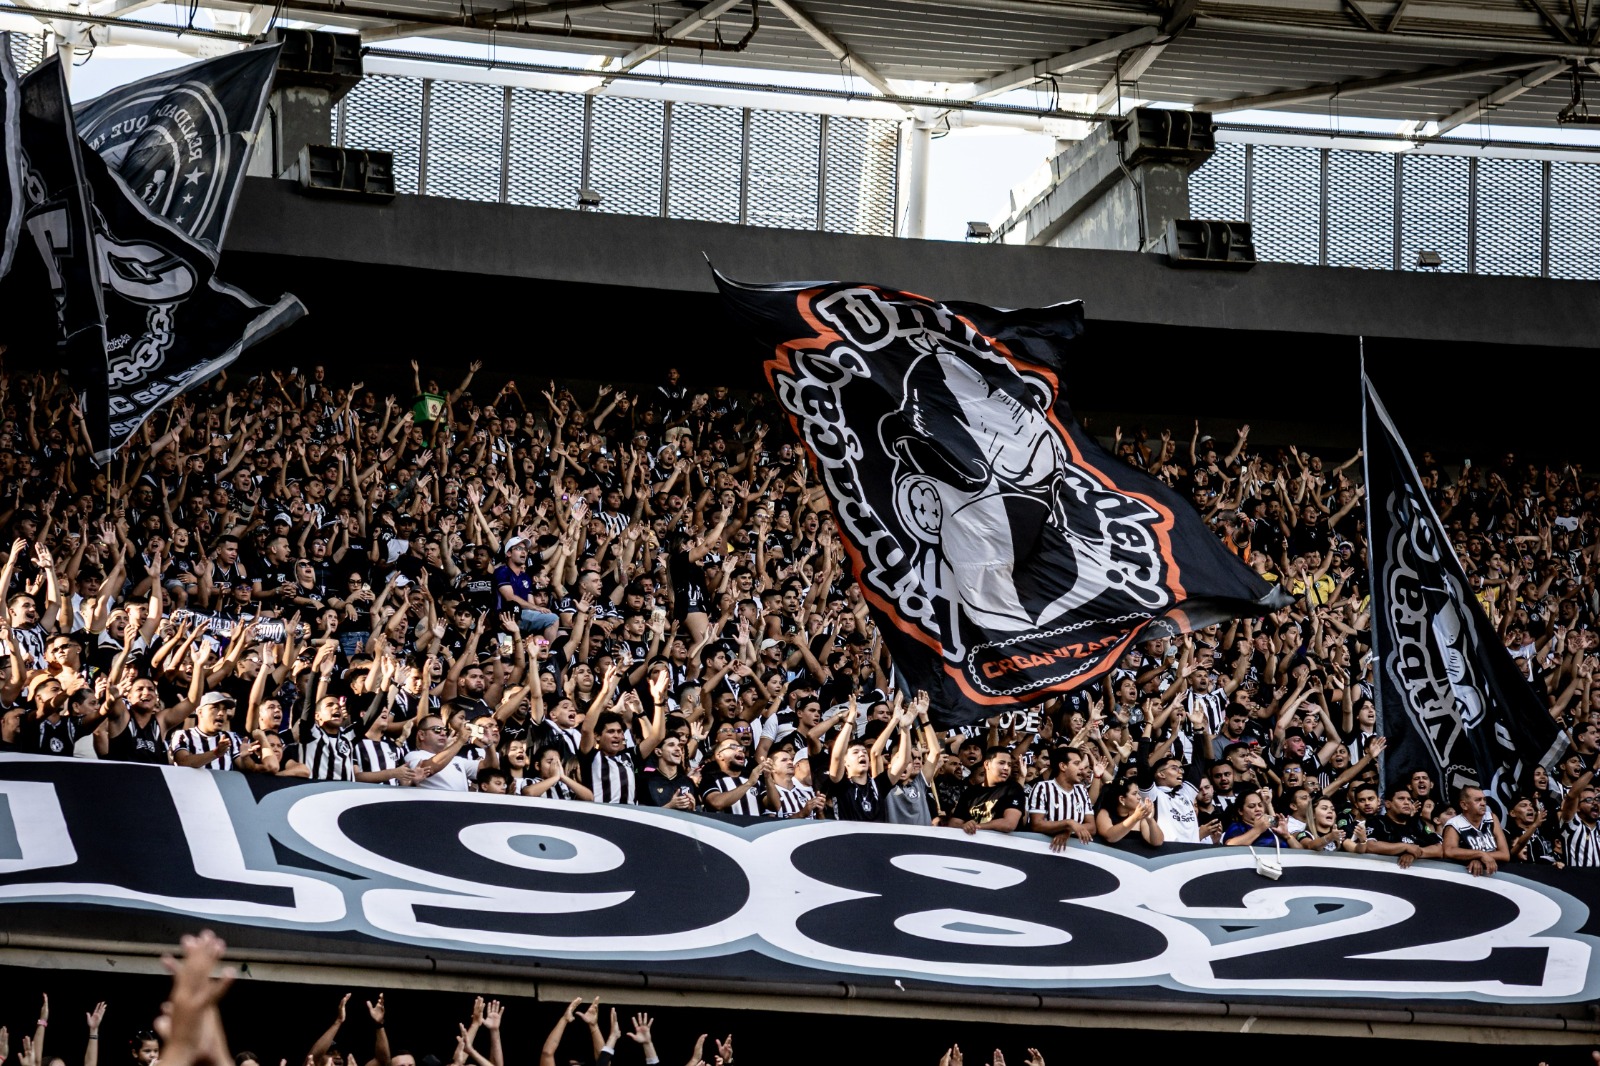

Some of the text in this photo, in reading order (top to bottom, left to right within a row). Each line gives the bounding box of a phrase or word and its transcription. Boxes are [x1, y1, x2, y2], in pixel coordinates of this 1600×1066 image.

[981, 628, 1131, 680] ORGANIZAD
[985, 710, 1040, 732] ODE
[0, 755, 1590, 1003] 1982
